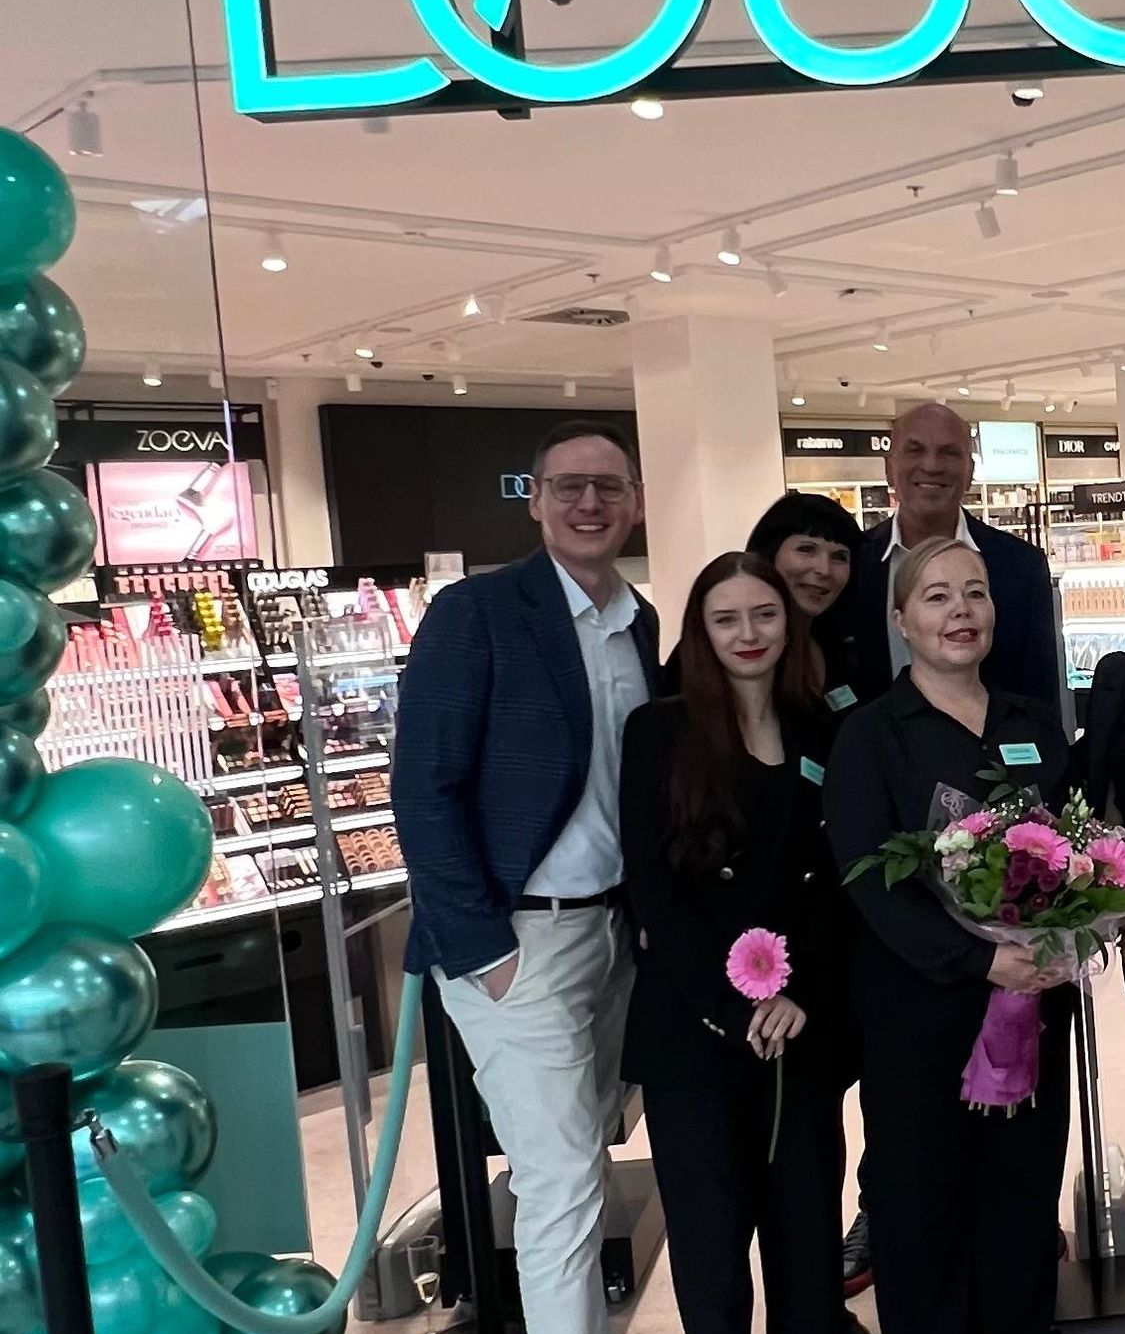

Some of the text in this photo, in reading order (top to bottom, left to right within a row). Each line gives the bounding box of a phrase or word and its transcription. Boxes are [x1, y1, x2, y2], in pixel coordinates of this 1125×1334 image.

[796, 436, 844, 450] rabanne
[1058, 440, 1085, 453] DIOR
[247, 569, 329, 592] DOUGLAS
